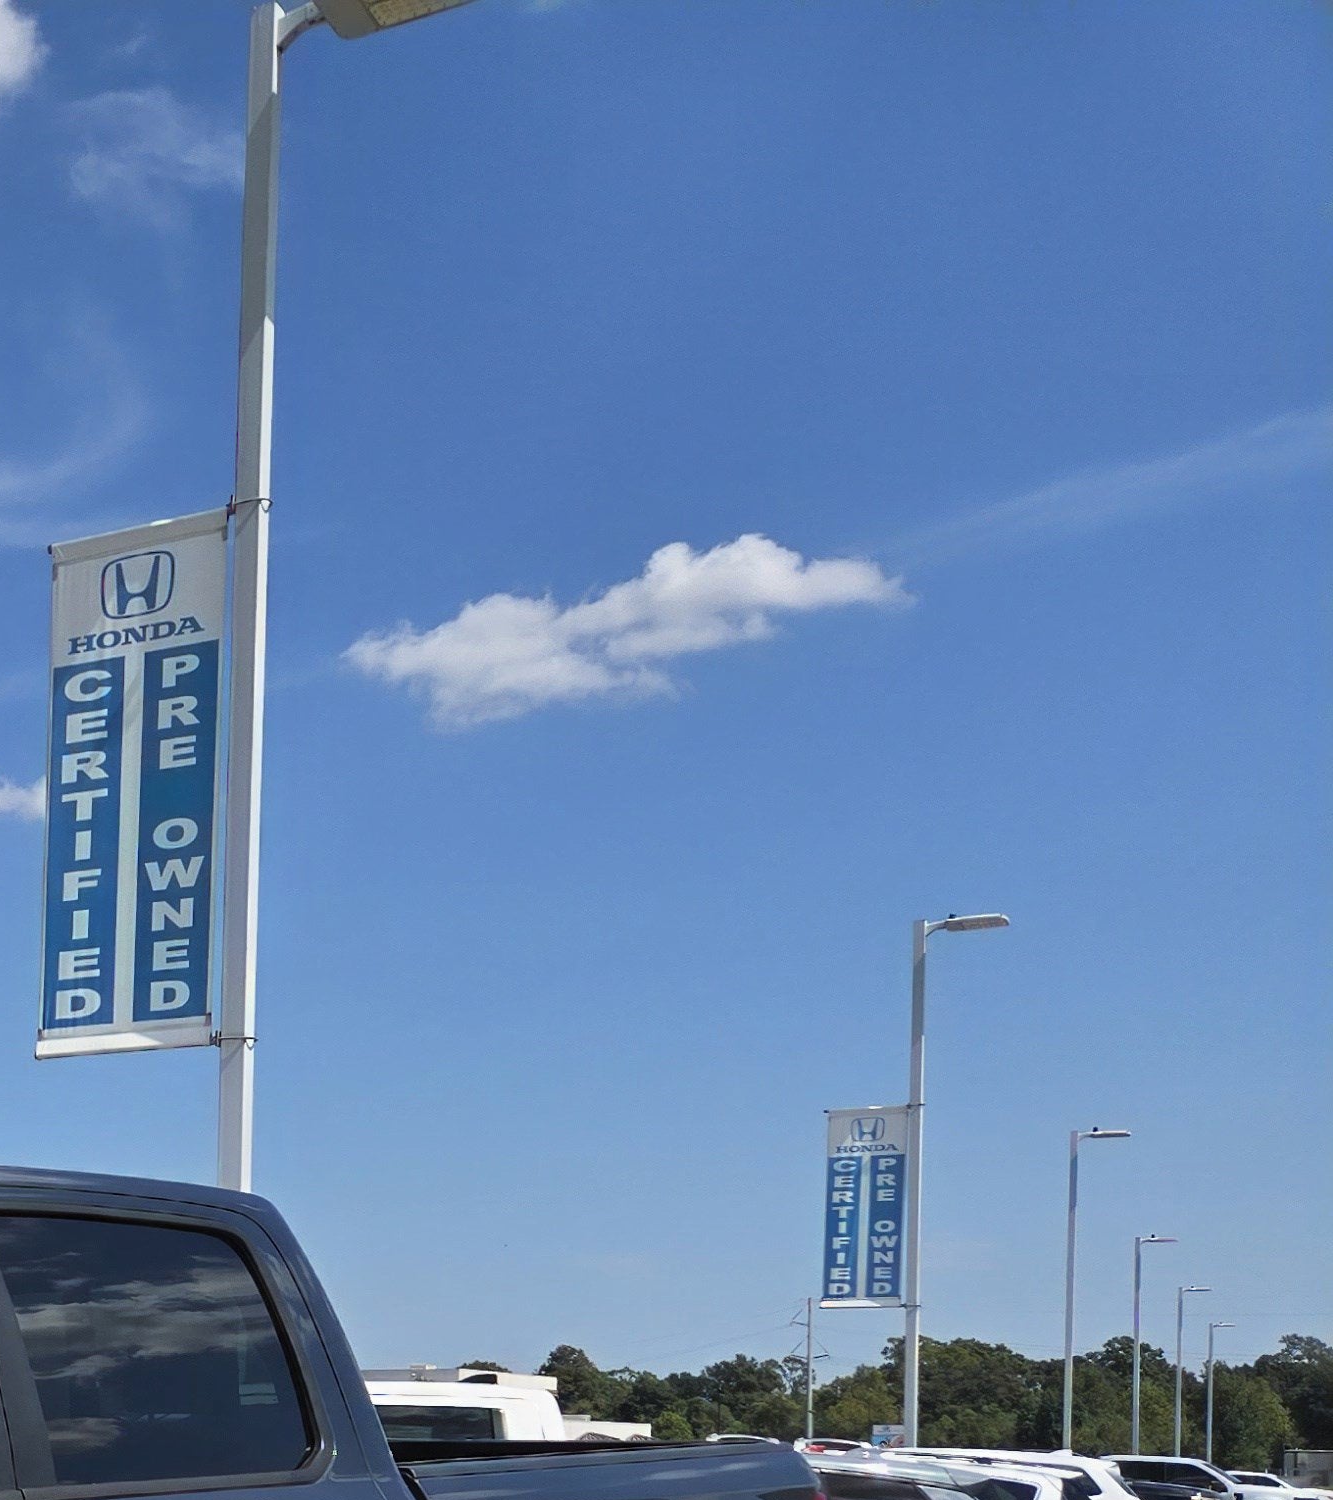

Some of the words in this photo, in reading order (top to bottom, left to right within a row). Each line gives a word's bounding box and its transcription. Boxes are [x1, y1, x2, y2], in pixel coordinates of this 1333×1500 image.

[68, 615, 205, 656] HONDA
[156, 653, 201, 771] PRE
[54, 669, 113, 1021] CERTIFIED
[144, 817, 206, 1012] OWNED
[835, 1143, 899, 1154] HONDA
[875, 1157, 897, 1202] PRE
[828, 1159, 858, 1296] CERTIFIED
[870, 1219, 899, 1295] OWNED
